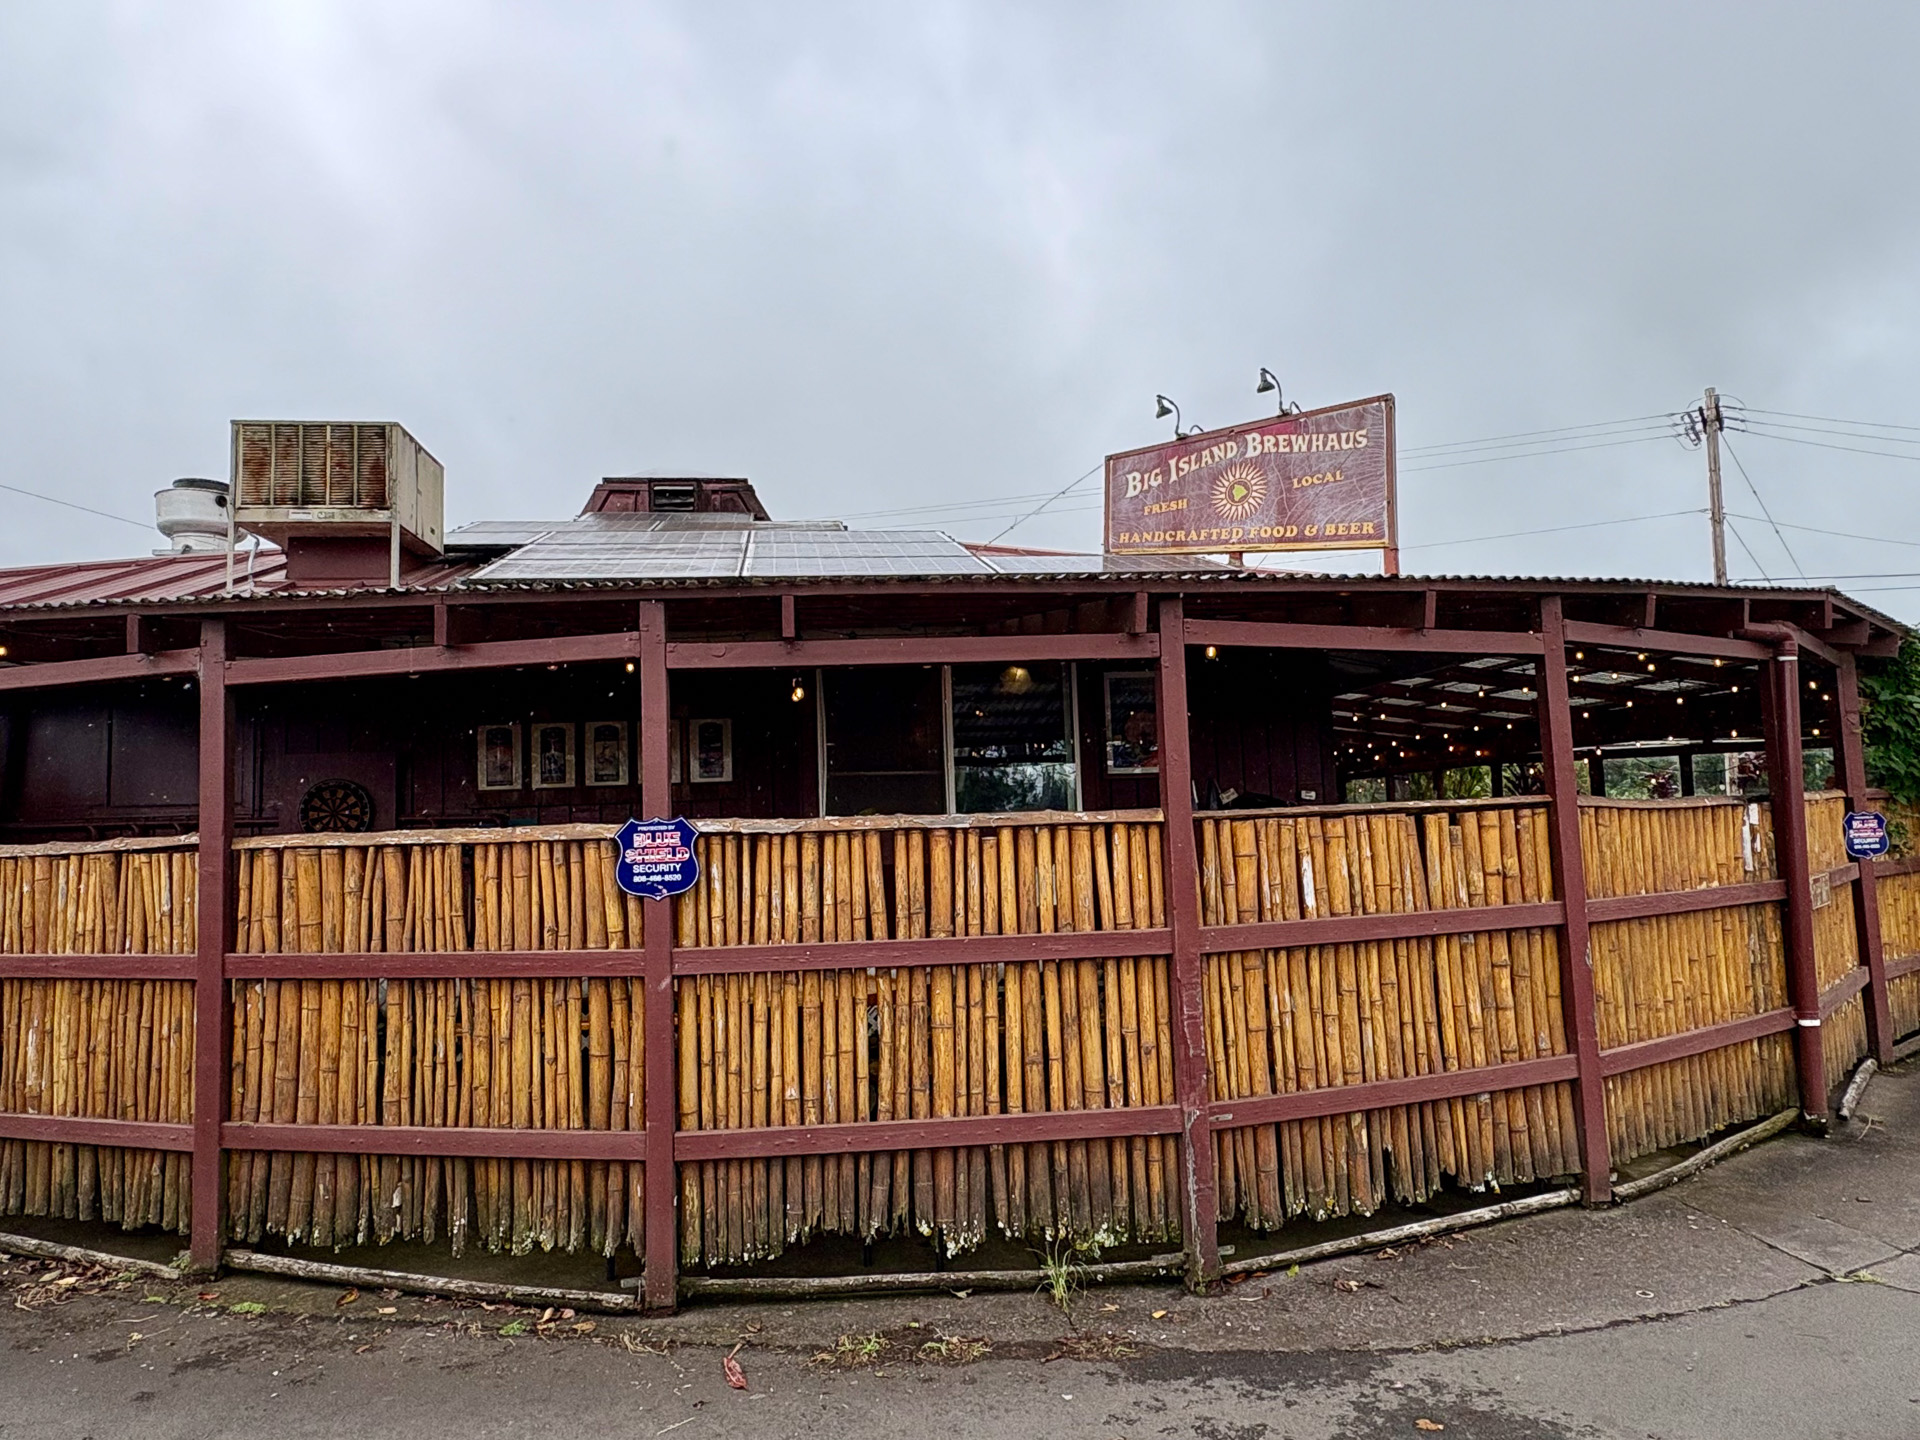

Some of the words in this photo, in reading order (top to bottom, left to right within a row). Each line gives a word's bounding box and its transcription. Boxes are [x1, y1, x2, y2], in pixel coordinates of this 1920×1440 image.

[1292, 470, 1344, 489] LOCAL
[1143, 498, 1188, 516] FRESH
[1119, 527, 1243, 544] HANDCRAFTED
[1249, 525, 1298, 539] FOOD
[1304, 524, 1317, 537] &
[1324, 521, 1375, 536] BEER
[633, 832, 681, 848] BLUE
[624, 847, 690, 864] SHIELD
[632, 863, 682, 873] SECURITY
